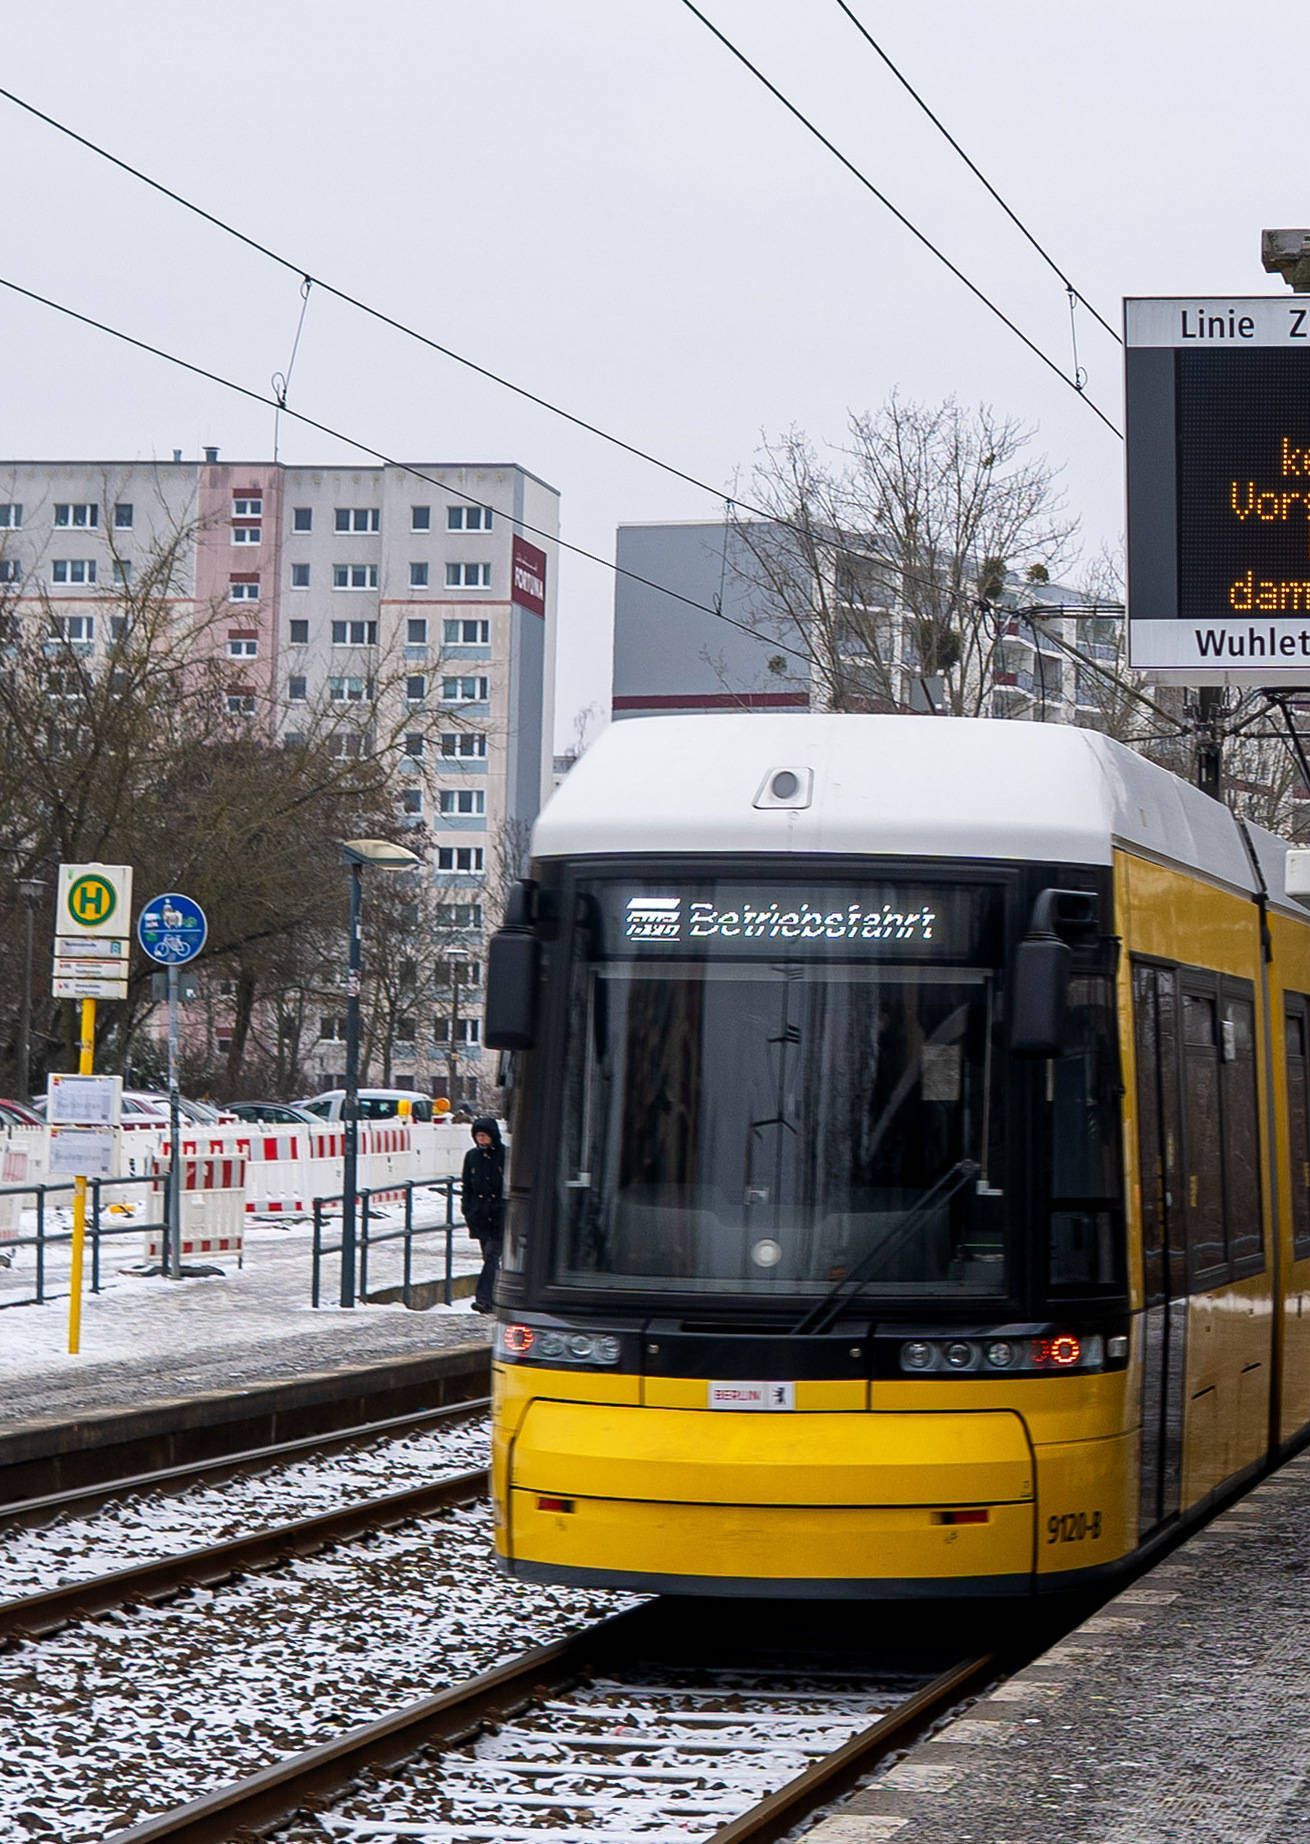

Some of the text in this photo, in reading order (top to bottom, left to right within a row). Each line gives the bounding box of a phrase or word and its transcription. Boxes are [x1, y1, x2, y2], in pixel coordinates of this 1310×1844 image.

[1181, 308, 1255, 338] Linie
[79, 887, 103, 914] H
[689, 902, 937, 939] Betriebsfahrt
[713, 1389, 762, 1401] BERLIN
